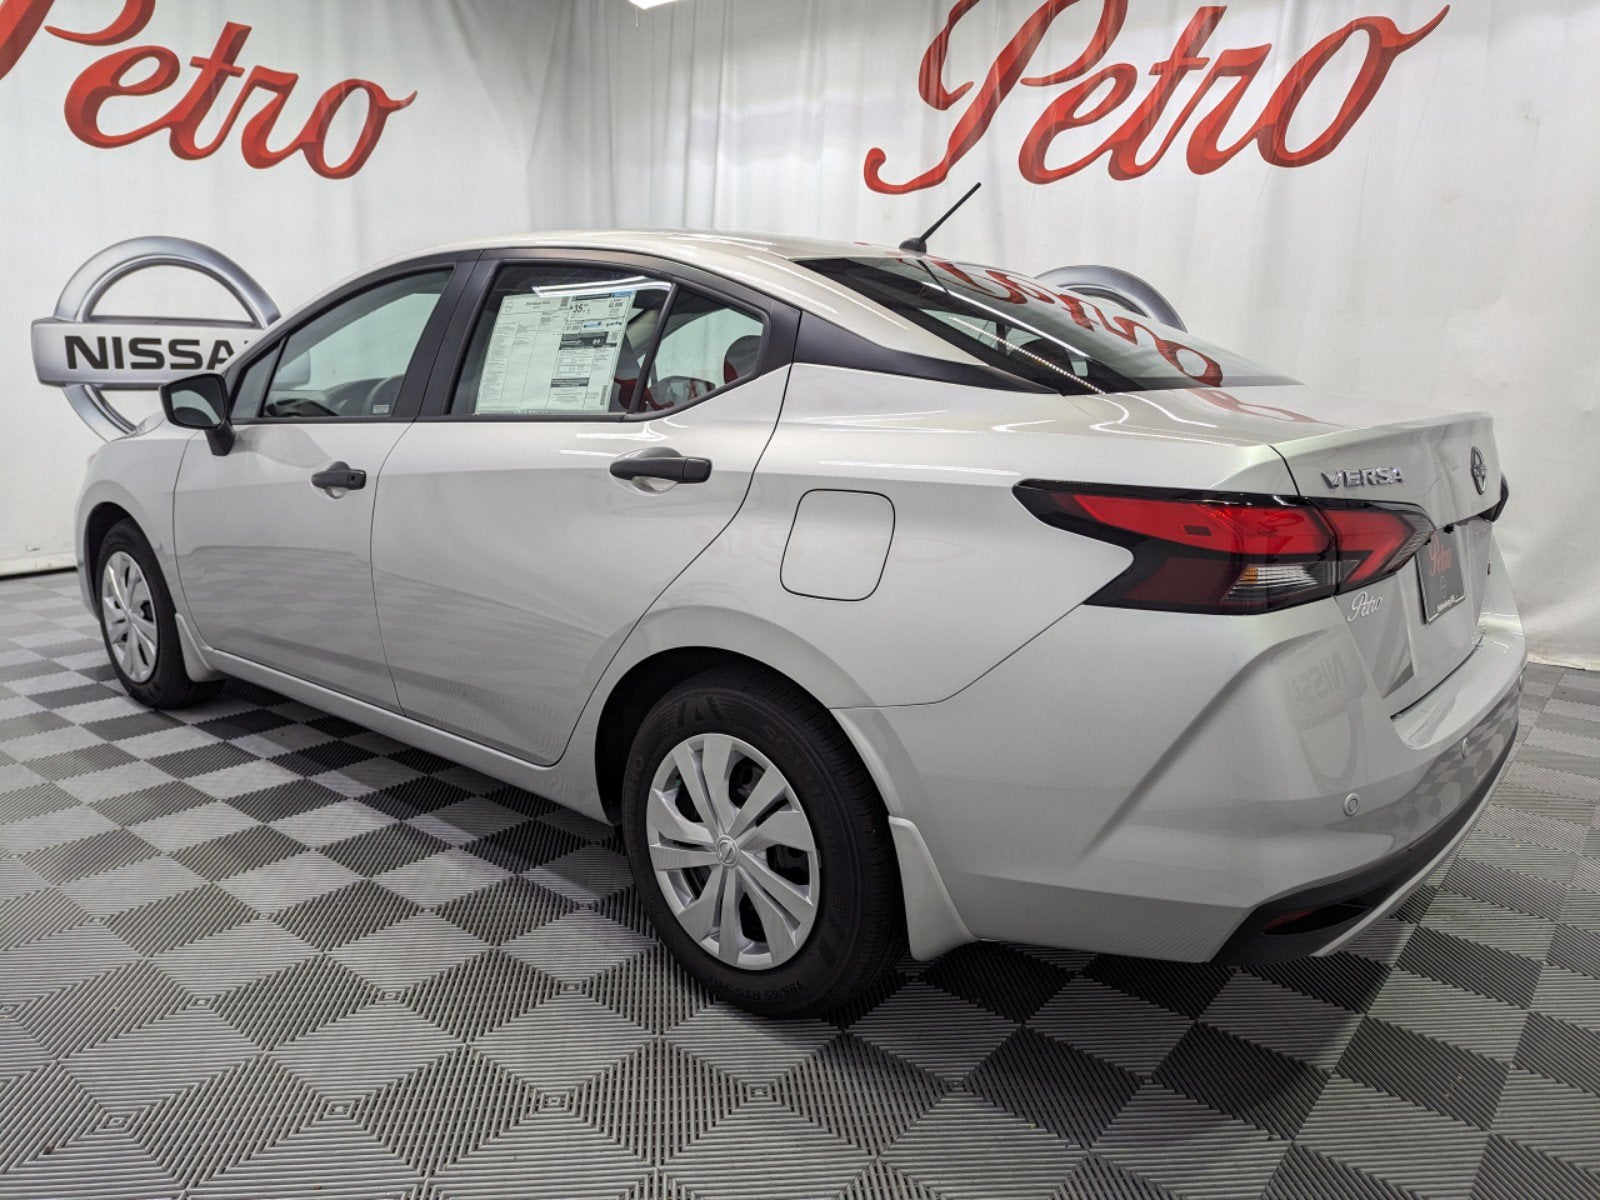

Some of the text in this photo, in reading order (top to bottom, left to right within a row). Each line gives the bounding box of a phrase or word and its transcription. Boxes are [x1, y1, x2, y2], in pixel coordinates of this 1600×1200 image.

[864, 0, 1451, 194] Petro
[64, 335, 249, 370] NISSA
[1320, 466, 1403, 490] VERSA
[1428, 534, 1453, 577] Petro
[1346, 591, 1384, 622] Petro
